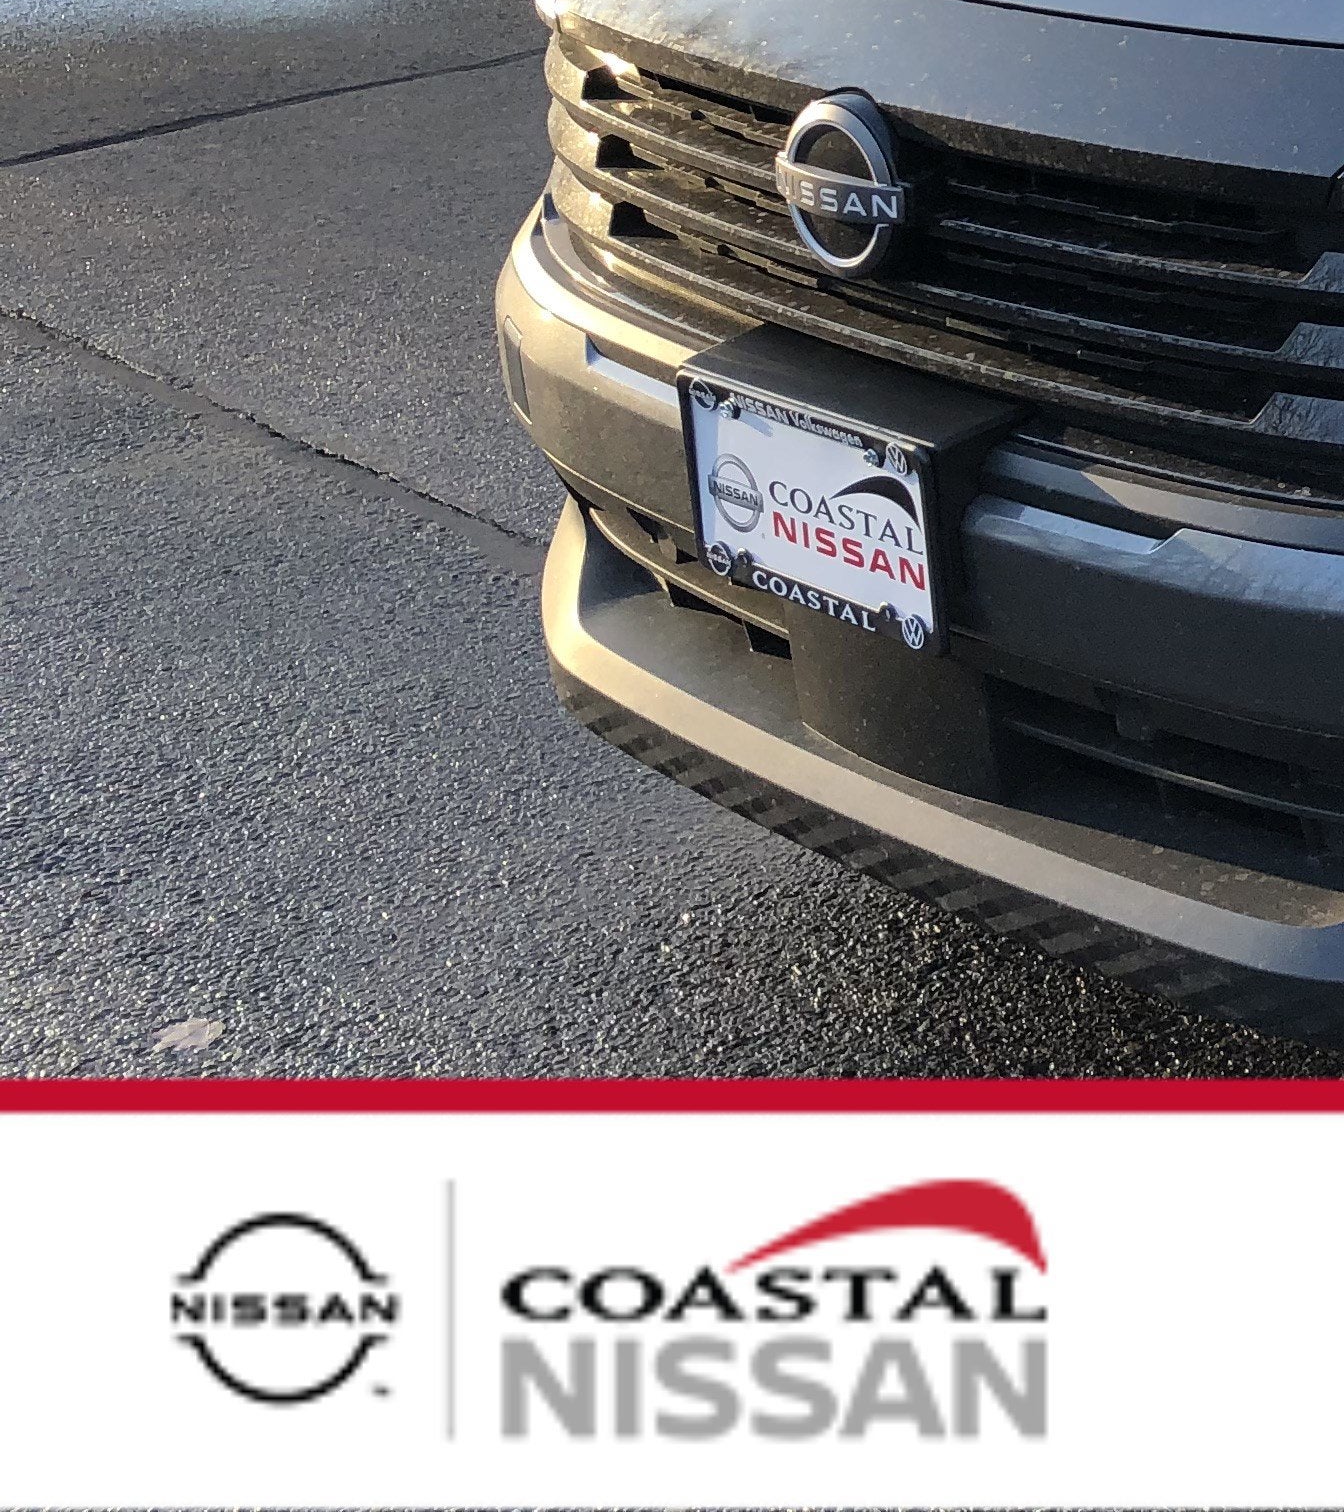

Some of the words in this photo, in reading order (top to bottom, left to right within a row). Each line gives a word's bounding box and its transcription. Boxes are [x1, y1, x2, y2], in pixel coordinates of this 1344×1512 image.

[776, 164, 898, 219] NISSAN
[730, 392, 789, 426] NISSAN
[788, 410, 864, 447] Volkswagen
[711, 478, 759, 506] NISSAN
[768, 480, 924, 556] COASTAL
[772, 510, 926, 592] NISSAN
[752, 570, 876, 632] COASTAL
